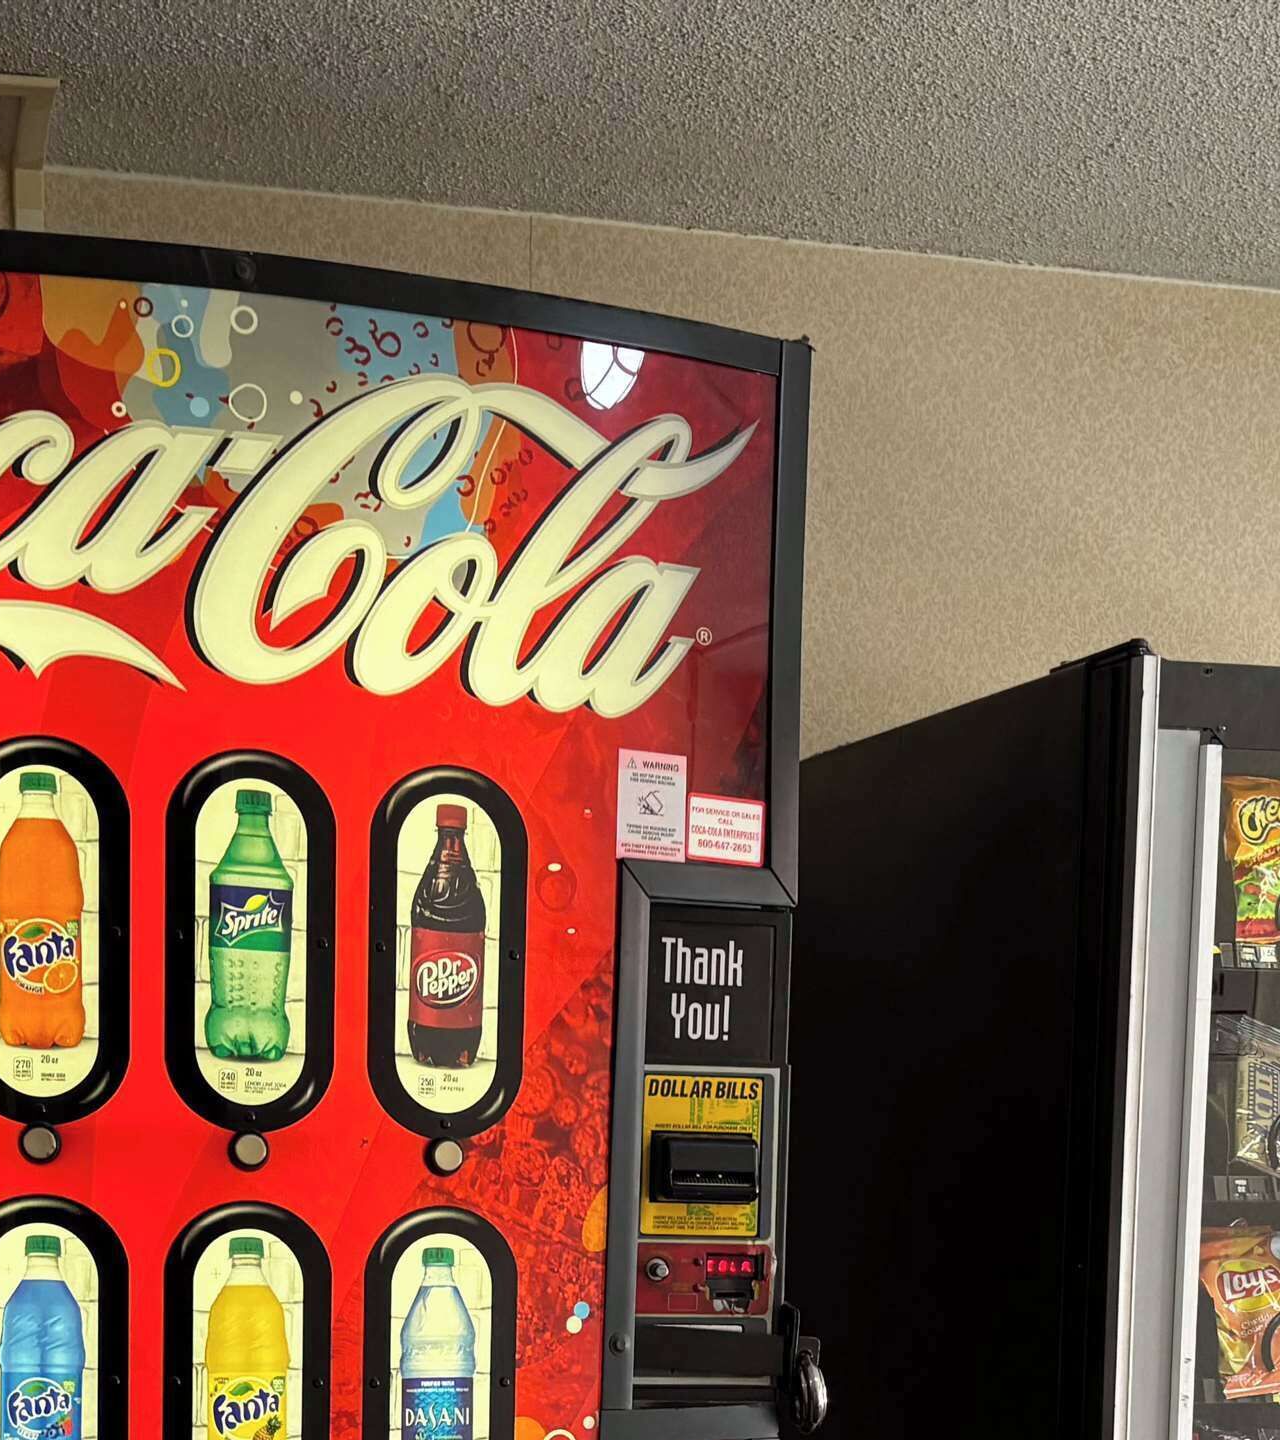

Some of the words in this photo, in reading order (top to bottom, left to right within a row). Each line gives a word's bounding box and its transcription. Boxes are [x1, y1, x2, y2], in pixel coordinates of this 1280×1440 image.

[642, 760, 679, 772] WARNING
[705, 807, 730, 816] SERVICE
[731, 810, 740, 818] OR
[741, 812, 760, 820] SALES
[718, 817, 733, 826] CALL
[691, 825, 722, 837] COCA-COLA
[723, 828, 760, 841] ENTERPRISES
[222, 905, 279, 937] Sprite
[4, 931, 75, 978] Fanta
[662, 937, 743, 987] Thank
[437, 957, 462, 979] Dr
[422, 961, 474, 999] Pepper
[671, 993, 730, 1041] You!
[16, 1060, 31, 1069] 270
[40, 1055, 51, 1064] 20
[221, 1072, 236, 1081] 240
[245, 1067, 255, 1077] 20
[443, 1073, 451, 1082] 20
[648, 1079, 712, 1098] DOLLAR
[715, 1081, 759, 1100] BILLS
[9, 1388, 70, 1425] Fanta
[213, 1389, 279, 1434] Fanta
[405, 1402, 470, 1432] DASANI
